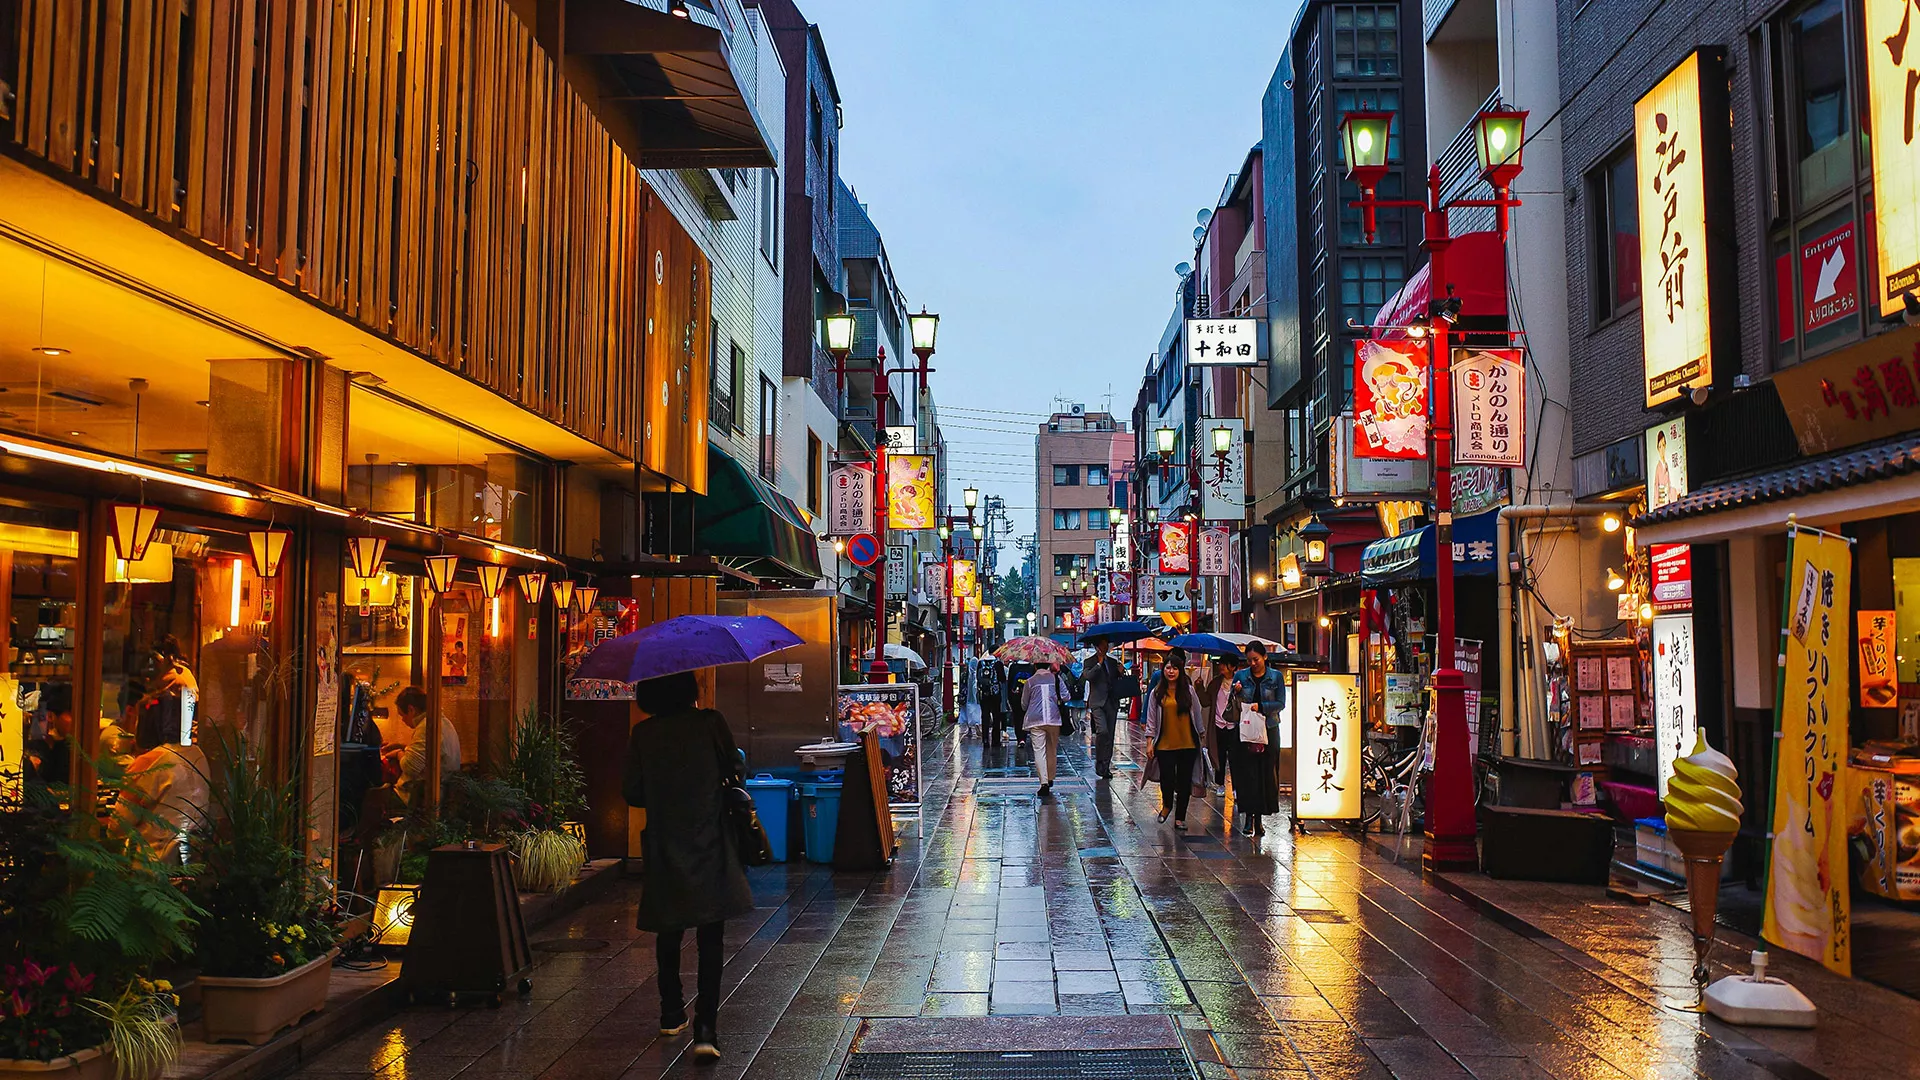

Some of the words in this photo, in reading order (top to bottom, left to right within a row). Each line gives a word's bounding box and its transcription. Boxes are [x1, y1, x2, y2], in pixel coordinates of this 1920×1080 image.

[1654, 113, 1688, 323] 江戸前
[1805, 230, 1851, 258] Entrance
[1809, 293, 1855, 325] 入り口はこちら
[1196, 324, 1237, 334] 手打そば
[1195, 341, 1251, 357] 十和田
[1471, 395, 1483, 450] メトロ商店会
[1489, 365, 1508, 453] かんのん通り
[1462, 452, 1518, 461] Kannon-dori
[840, 491, 848, 527] メトロ商店会
[852, 472, 864, 527] かんのん通り
[1214, 533, 1223, 570] かんのん通り
[1315, 697, 1345, 793] 焼肉岡本
[1803, 649, 1818, 838] ソフトクリーム
